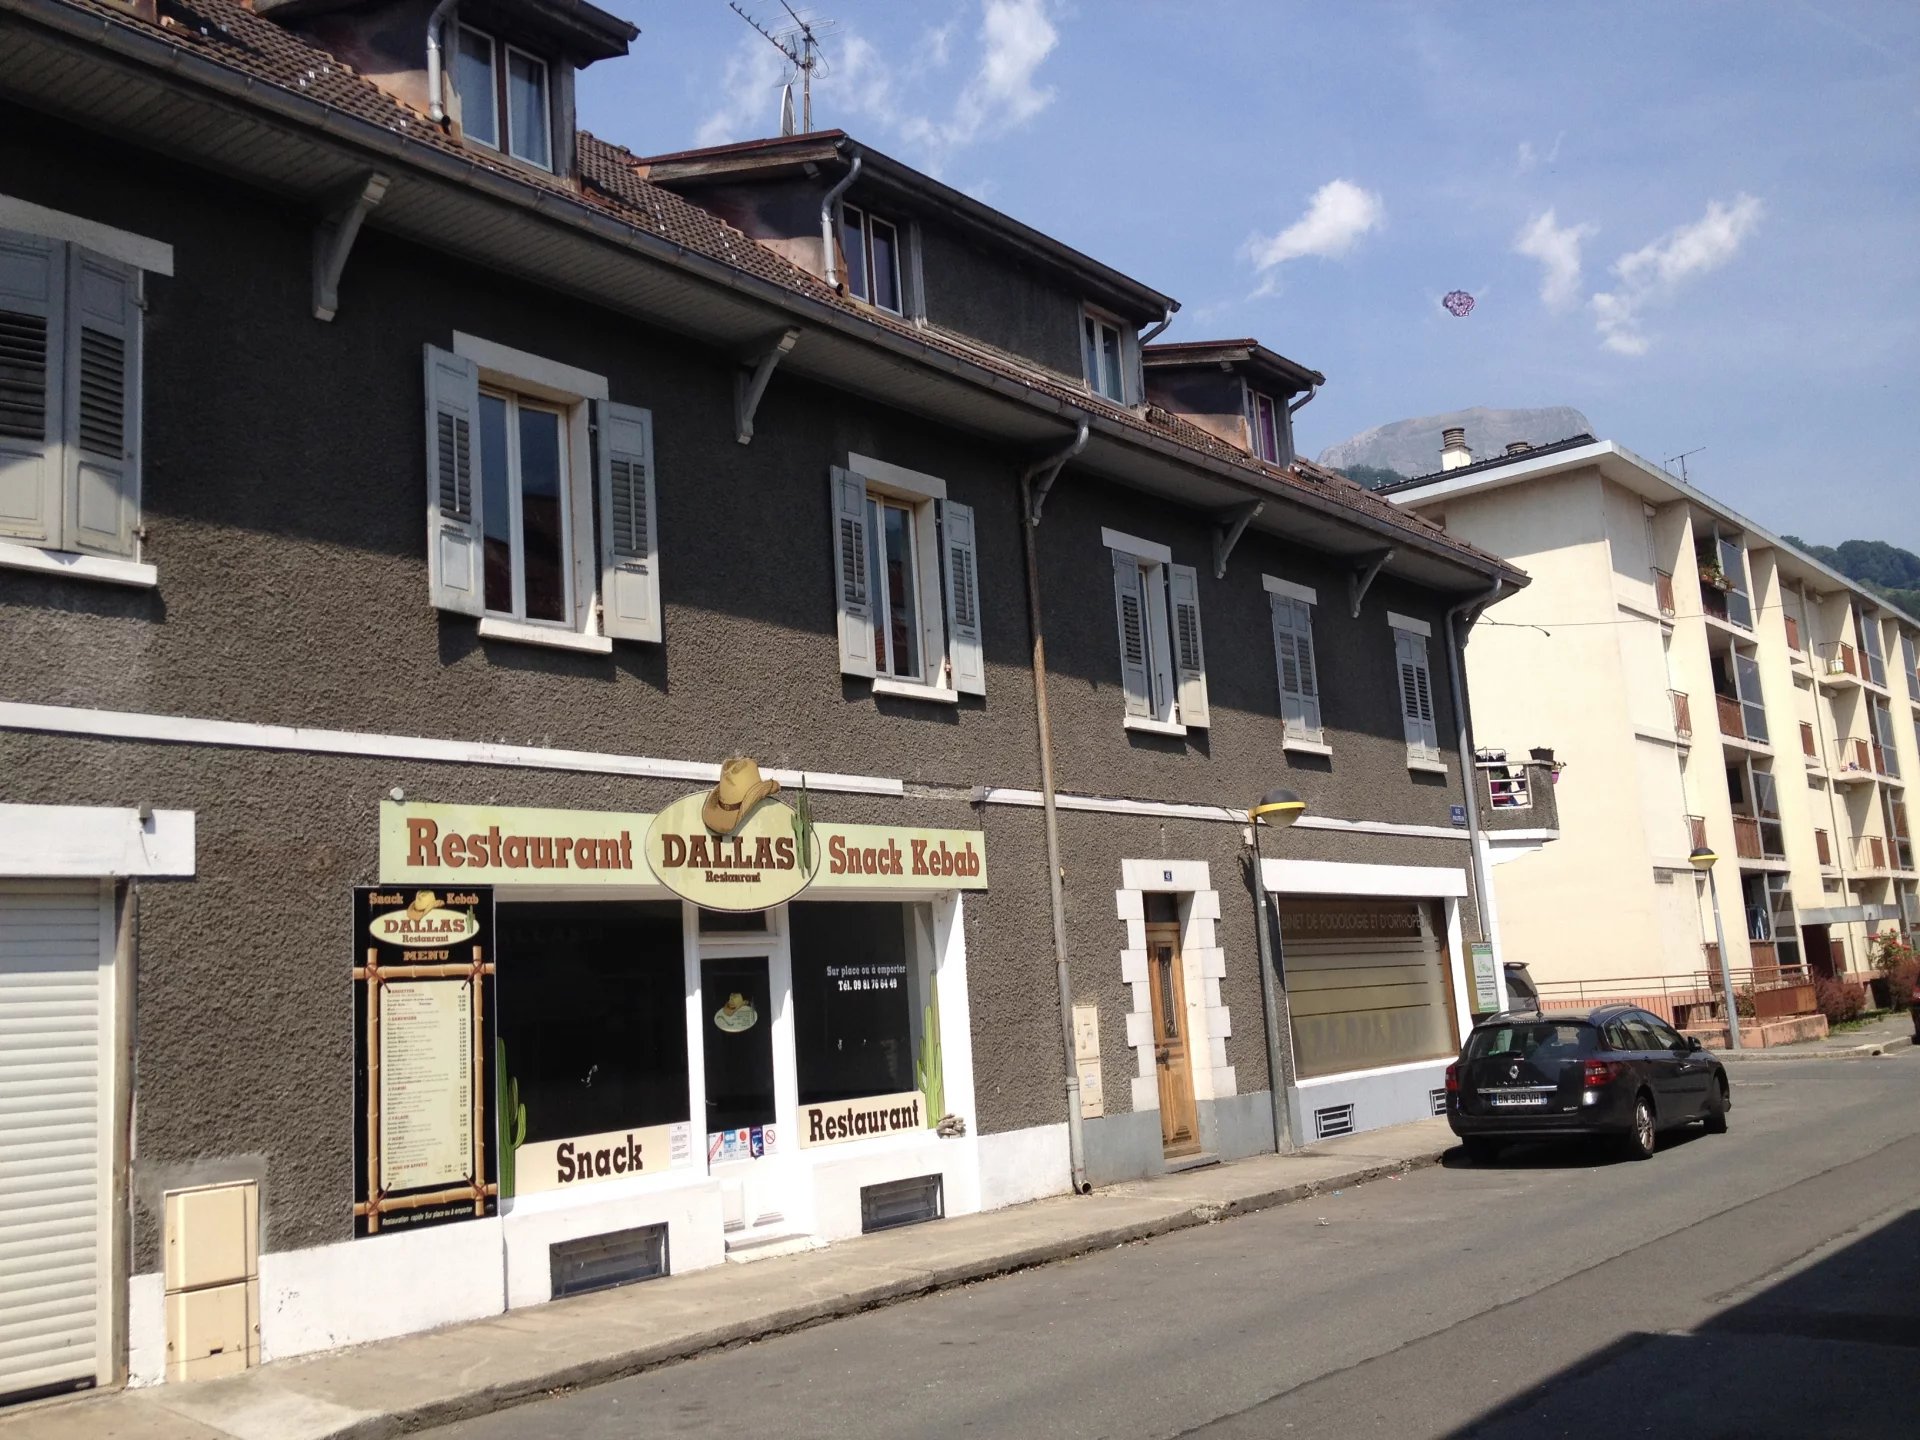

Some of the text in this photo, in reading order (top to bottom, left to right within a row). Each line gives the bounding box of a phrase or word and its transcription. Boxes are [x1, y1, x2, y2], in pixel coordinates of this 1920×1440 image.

[407, 818, 632, 870] Restaurant
[662, 834, 796, 870] DALLAS
[829, 835, 980, 877] Snack Kebab
[705, 869, 761, 884] Restaurant
[369, 891, 479, 905] Snack Kebab
[384, 918, 466, 933] DALLAS
[402, 934, 449, 943] Restaurant
[403, 950, 449, 961] MENU
[826, 966, 839, 976] Sur
[841, 965, 859, 977] place
[871, 964, 876, 974] à
[877, 965, 906, 976] emporter
[838, 980, 853, 991] Tél.
[853, 980, 862, 990] 09
[809, 1099, 919, 1142] Restaurant
[557, 1133, 643, 1184] Snack
[382, 1215, 409, 1225] Restauration
[410, 1213, 424, 1222] rapide
[432, 1210, 444, 1219] place
[454, 1206, 473, 1215] emporter
